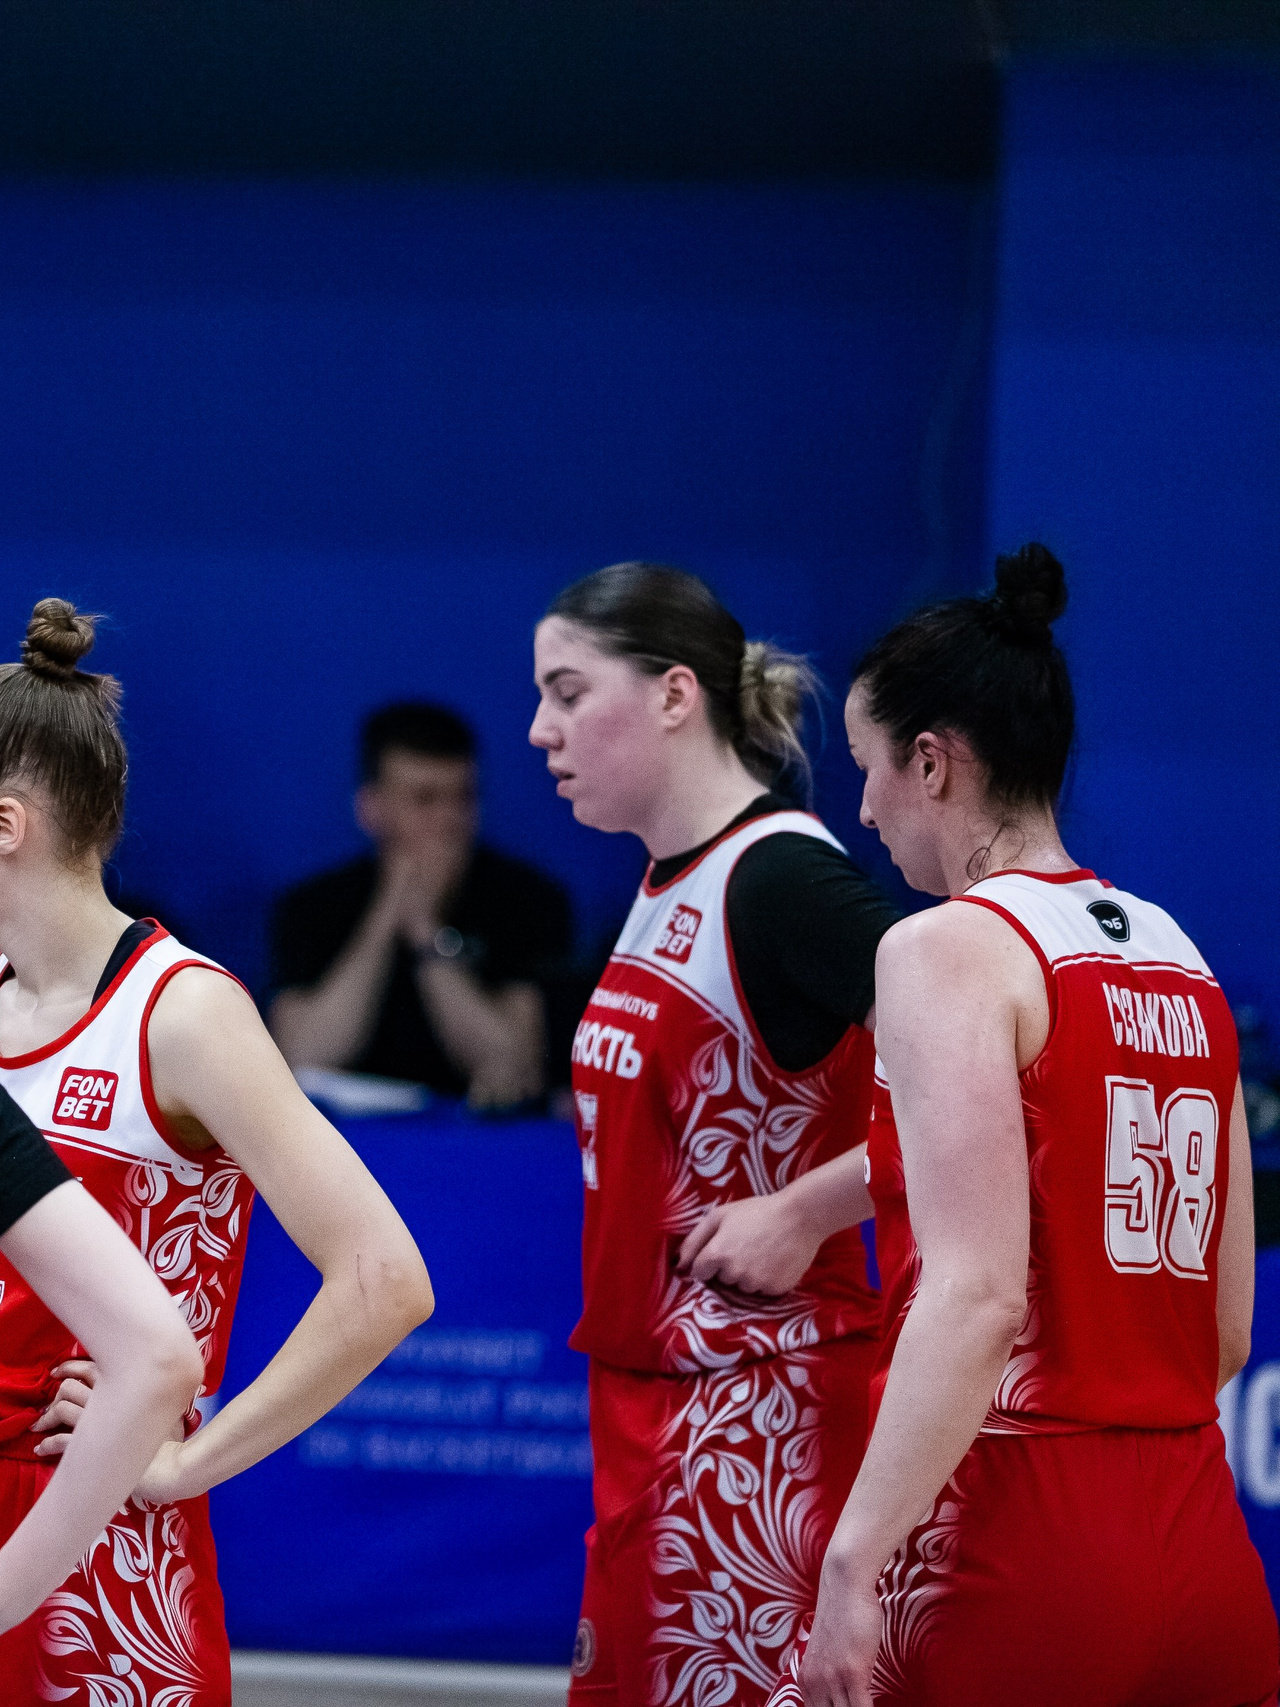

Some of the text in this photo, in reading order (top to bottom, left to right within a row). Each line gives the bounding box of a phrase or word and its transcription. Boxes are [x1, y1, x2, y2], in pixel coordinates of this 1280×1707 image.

[62, 1073, 115, 1099] FON
[56, 1096, 110, 1122] BET
[1104, 1075, 1220, 1281] 58
